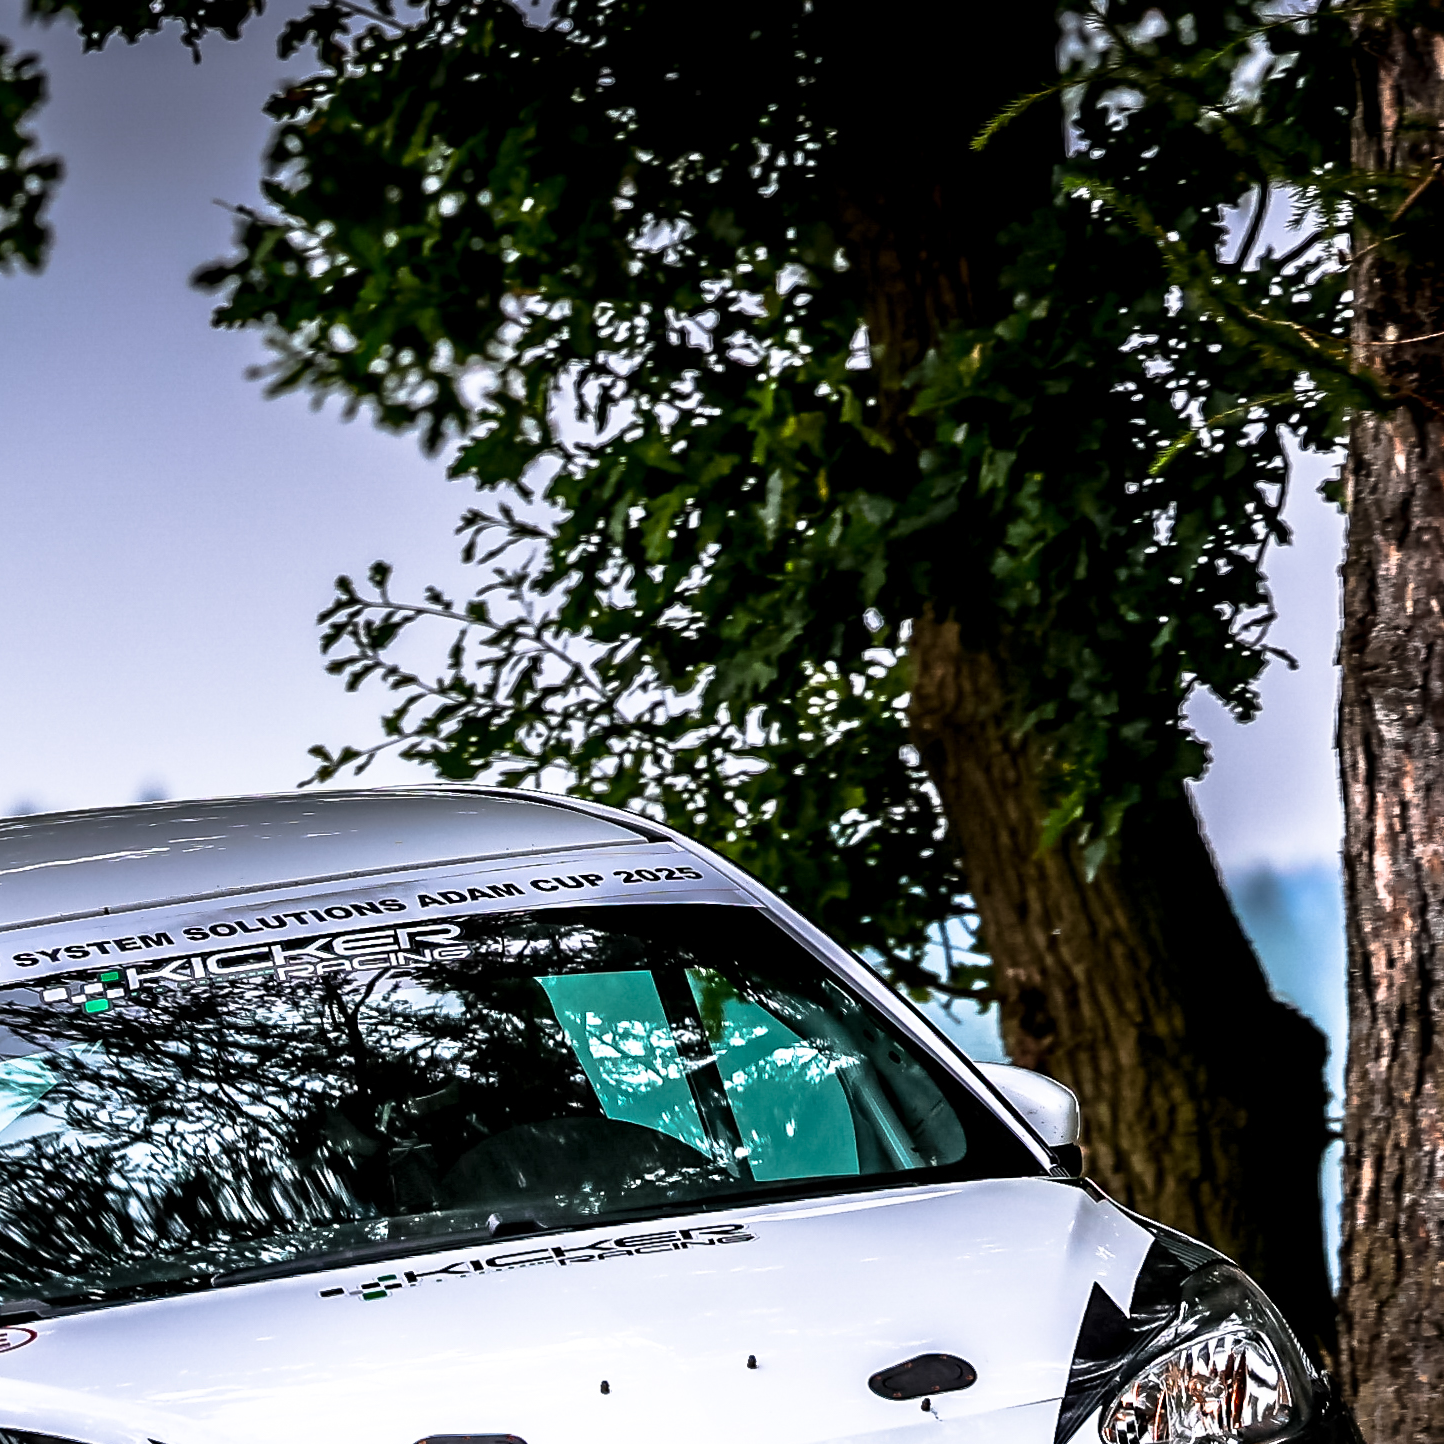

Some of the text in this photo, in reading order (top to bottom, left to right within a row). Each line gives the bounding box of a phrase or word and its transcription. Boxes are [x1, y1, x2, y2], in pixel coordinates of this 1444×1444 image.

[14, 931, 174, 967] SYSTEM
[182, 898, 407, 942] SOLUTIONS
[419, 883, 525, 908] ADAM
[530, 872, 605, 893] CUP
[613, 867, 704, 884] 2025
[127, 924, 461, 989] KICKER
[276, 944, 474, 981] RACING
[404, 1223, 745, 1283] KICKER
[557, 1234, 758, 1266] RACING
